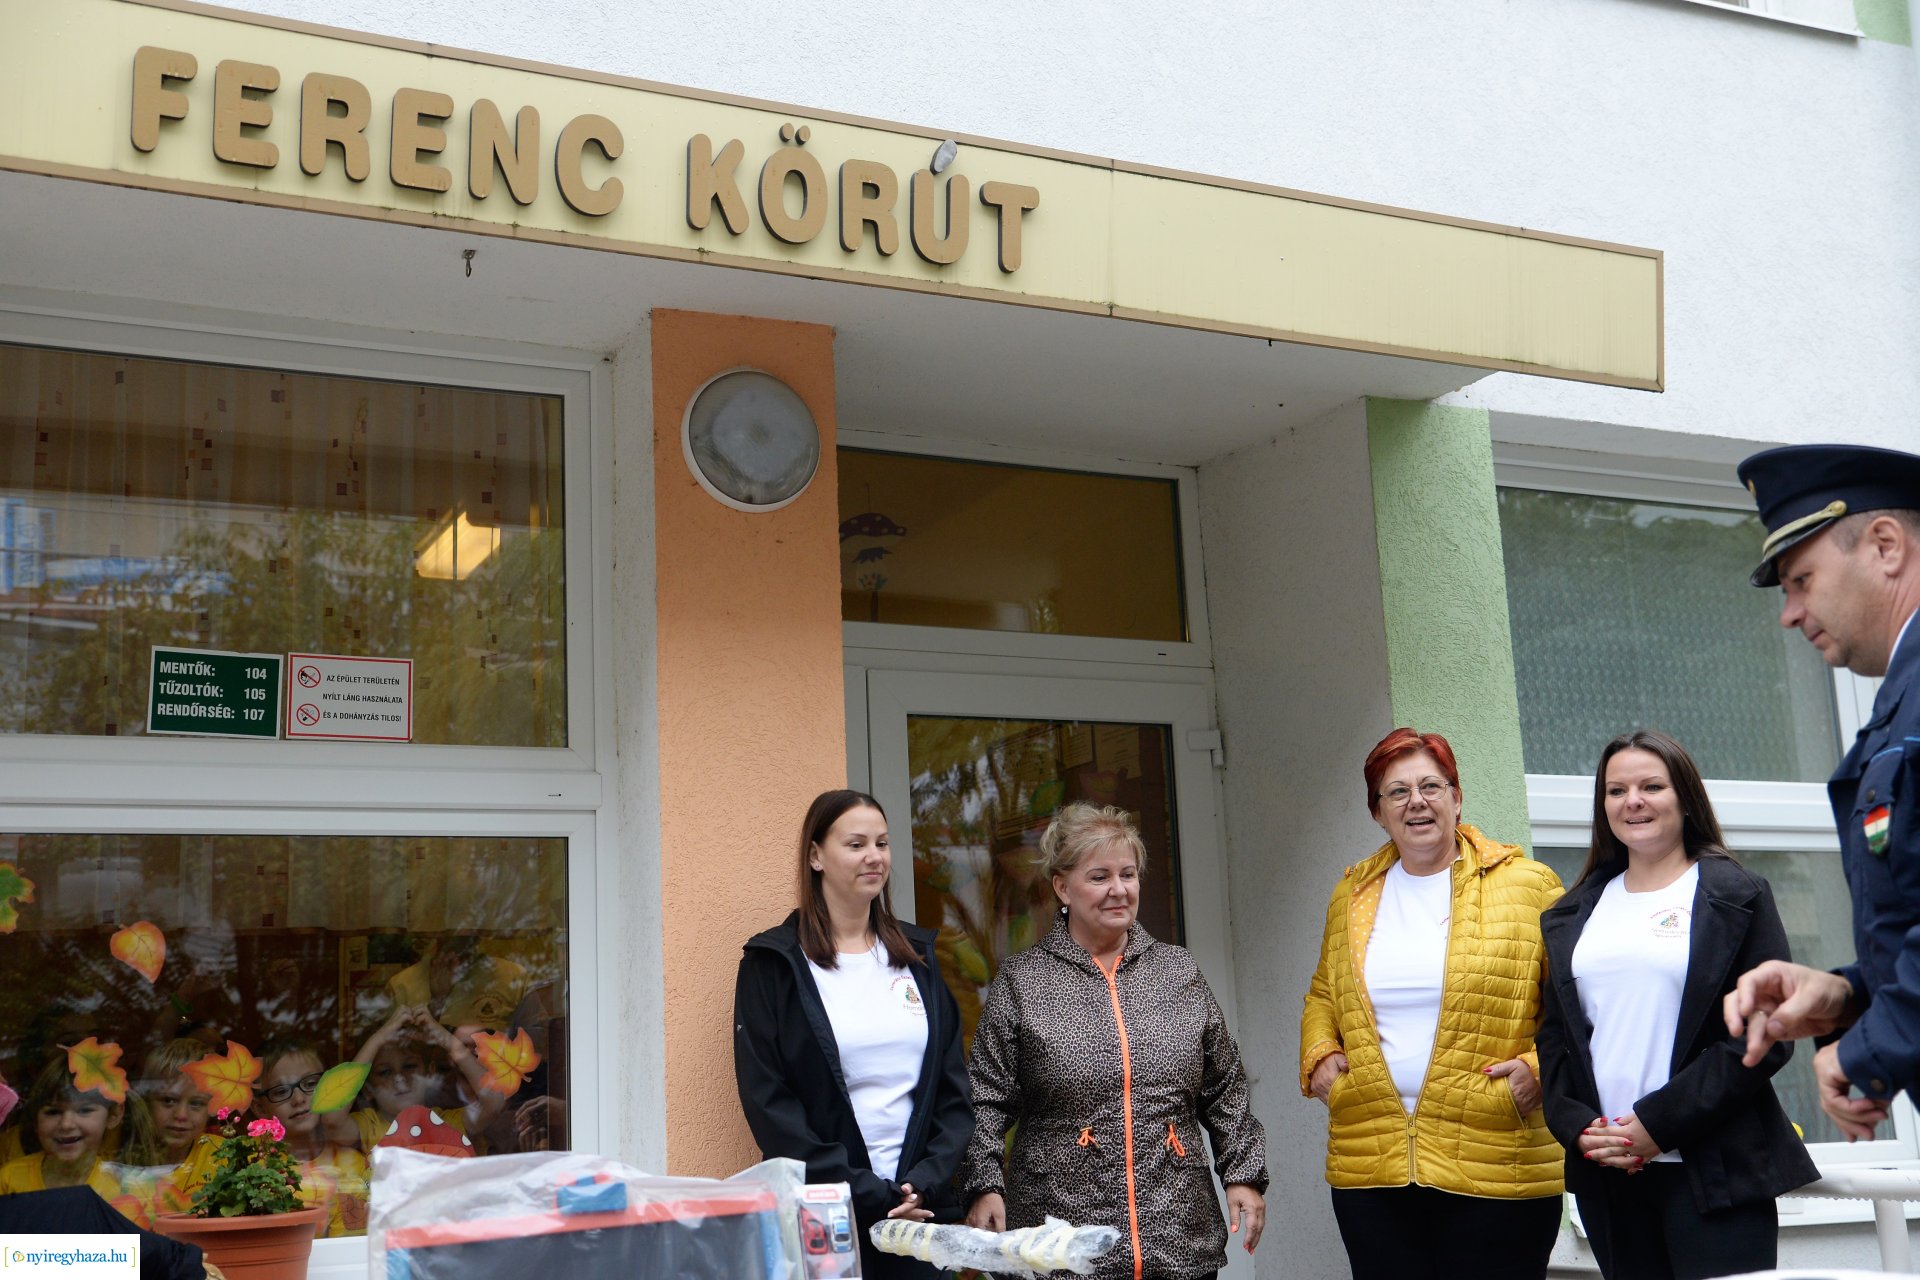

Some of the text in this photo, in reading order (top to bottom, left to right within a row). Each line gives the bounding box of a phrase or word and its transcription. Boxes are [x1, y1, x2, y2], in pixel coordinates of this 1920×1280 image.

[130, 45, 1040, 274] FERENC KÖRÚT
[159, 661, 267, 680] MENTŐK: 104
[336, 674, 361, 683] ÉPÜLET
[363, 676, 400, 685] TERÜLETÉN
[159, 680, 266, 700] TŰZOLTÓK: 105
[322, 692, 403, 704] NYÍLT LÁNG HASZNÁLATA
[157, 702, 265, 721] RENDŐRSÉG: 107
[322, 709, 402, 722] ÉS A DOHÁNYZÁS TILOS!
